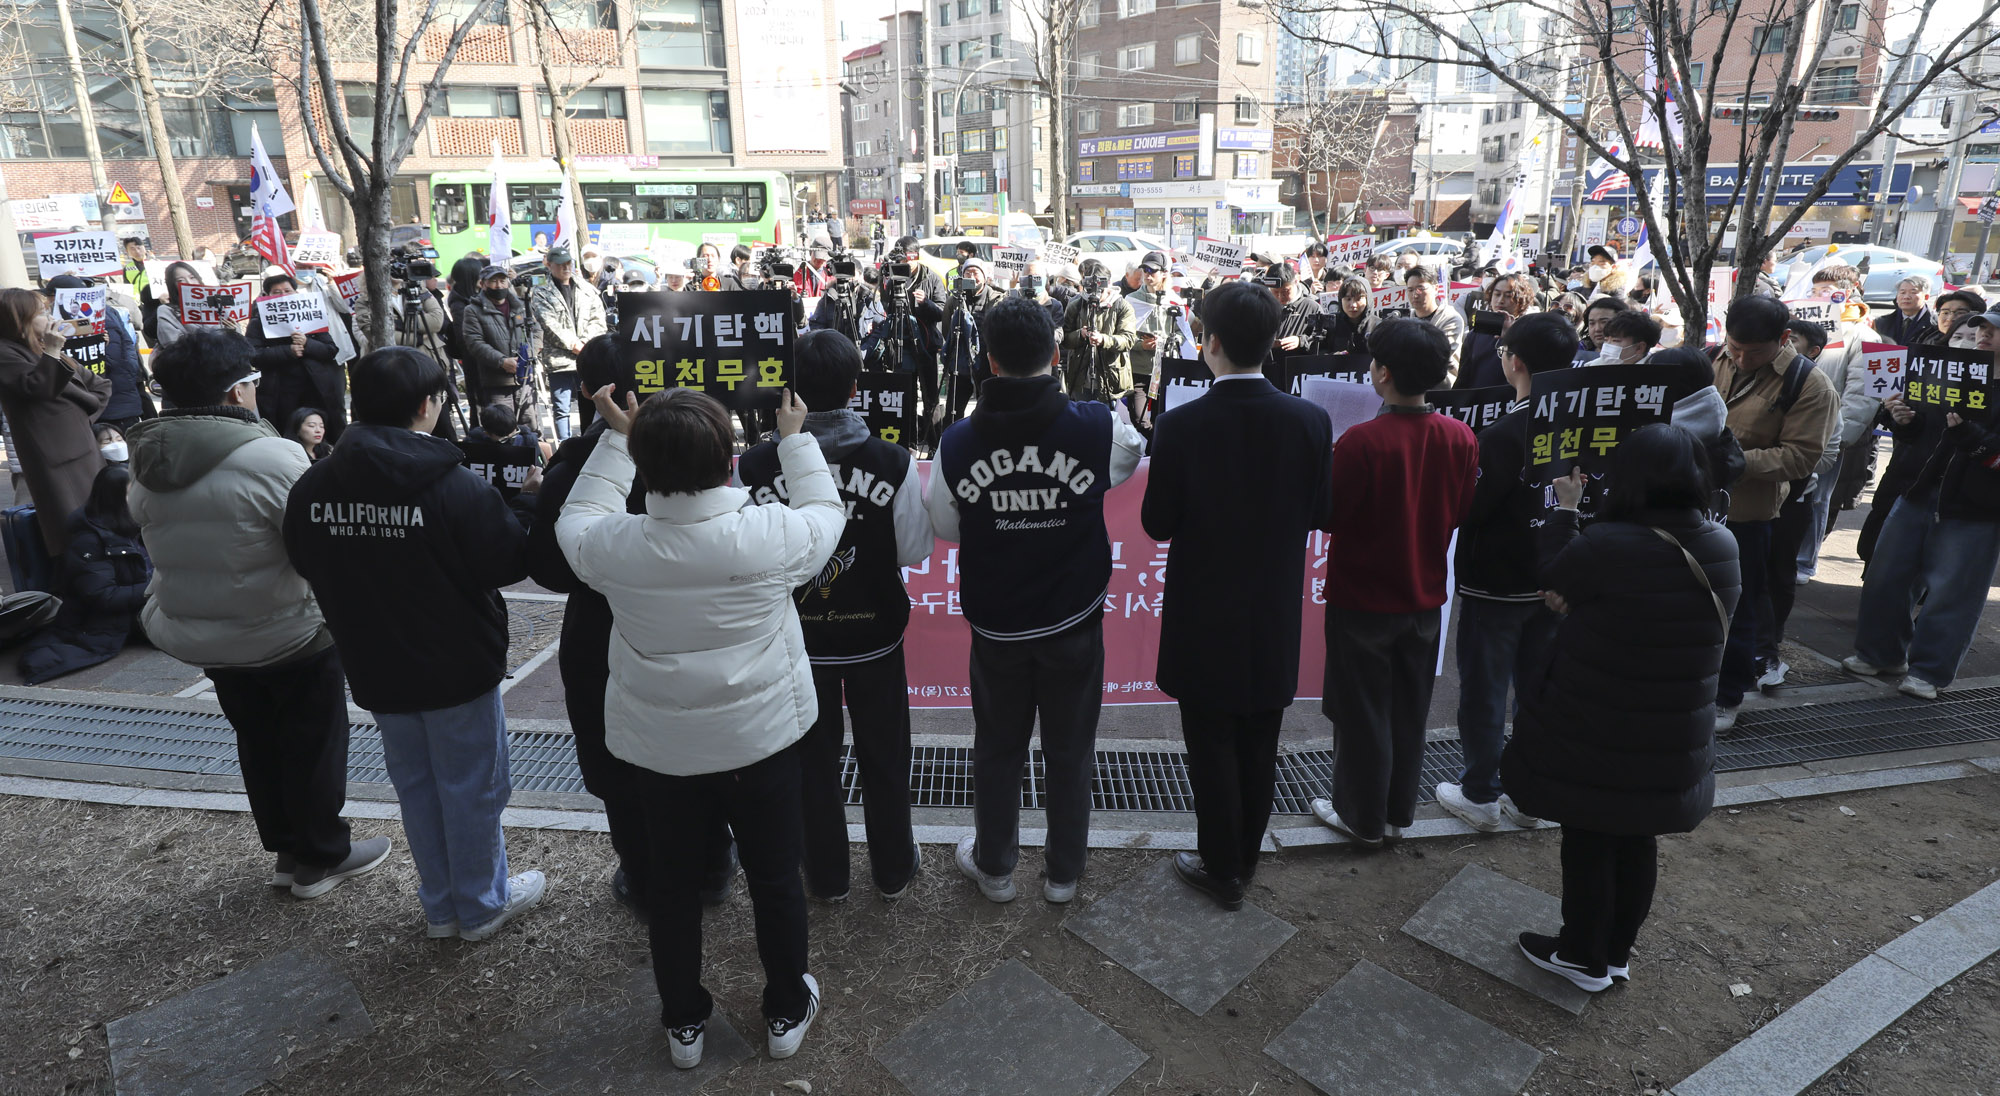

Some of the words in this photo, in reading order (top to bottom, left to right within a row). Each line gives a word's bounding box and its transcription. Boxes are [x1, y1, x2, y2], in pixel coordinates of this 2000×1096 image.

[1133, 136, 1166, 150] 다이어트
[53, 238, 104, 251] 지키자!
[1206, 243, 1239, 260] 지키자!
[1329, 239, 1371, 255] 부정선거
[41, 251, 117, 265] 자유대한민국
[1000, 251, 1029, 262] 지키자!
[1195, 251, 1242, 270] 자유대한민국
[1330, 249, 1373, 266] 수사하라
[265, 298, 318, 311] 척결하자!
[188, 309, 247, 321] STEAL
[265, 311, 323, 325] 반국가세력
[631, 312, 785, 349] 사기탄핵
[634, 357, 788, 394] 원천무효
[1908, 356, 1990, 385] 사기탄핵
[1534, 385, 1668, 423] 사기탄핵
[1907, 381, 1987, 410] 원천무효
[956, 446, 1095, 504] SOGANG
[754, 463, 895, 508] SOANG
[989, 488, 1068, 512] UNIV.
[310, 502, 424, 527] CALIFORNIA
[380, 527, 406, 539] 1849
[995, 518, 1066, 531] Mathematics
[826, 611, 876, 622] Engineering
